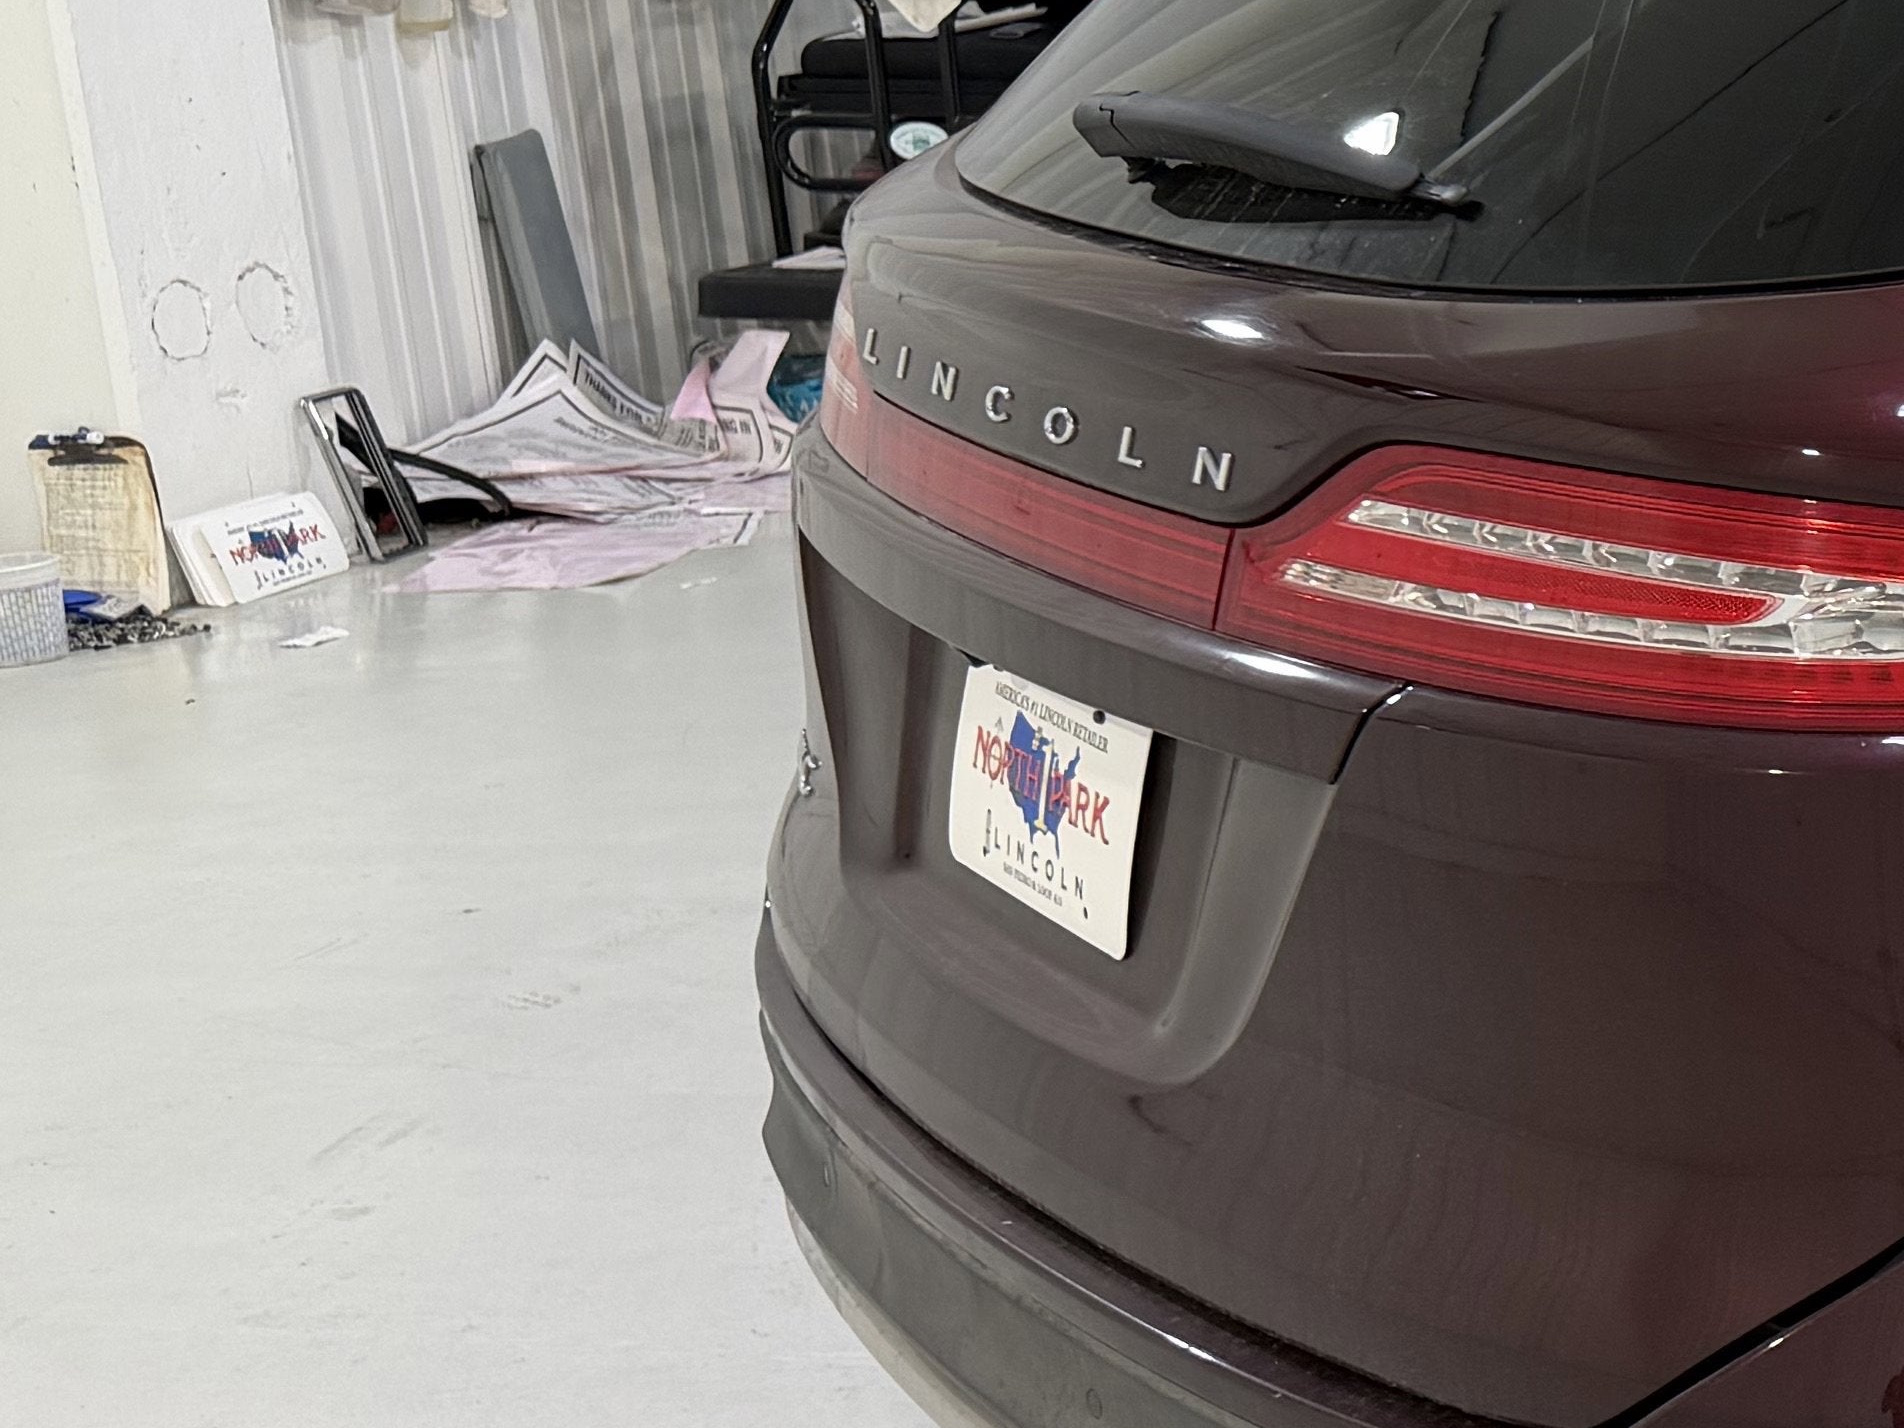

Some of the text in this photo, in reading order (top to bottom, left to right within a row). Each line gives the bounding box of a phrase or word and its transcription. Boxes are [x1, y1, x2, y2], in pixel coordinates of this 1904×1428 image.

[862, 327, 1235, 492] LINCOLN
[972, 724, 1111, 846] NORTH PARK
[993, 825, 1084, 901] LINCOLN
